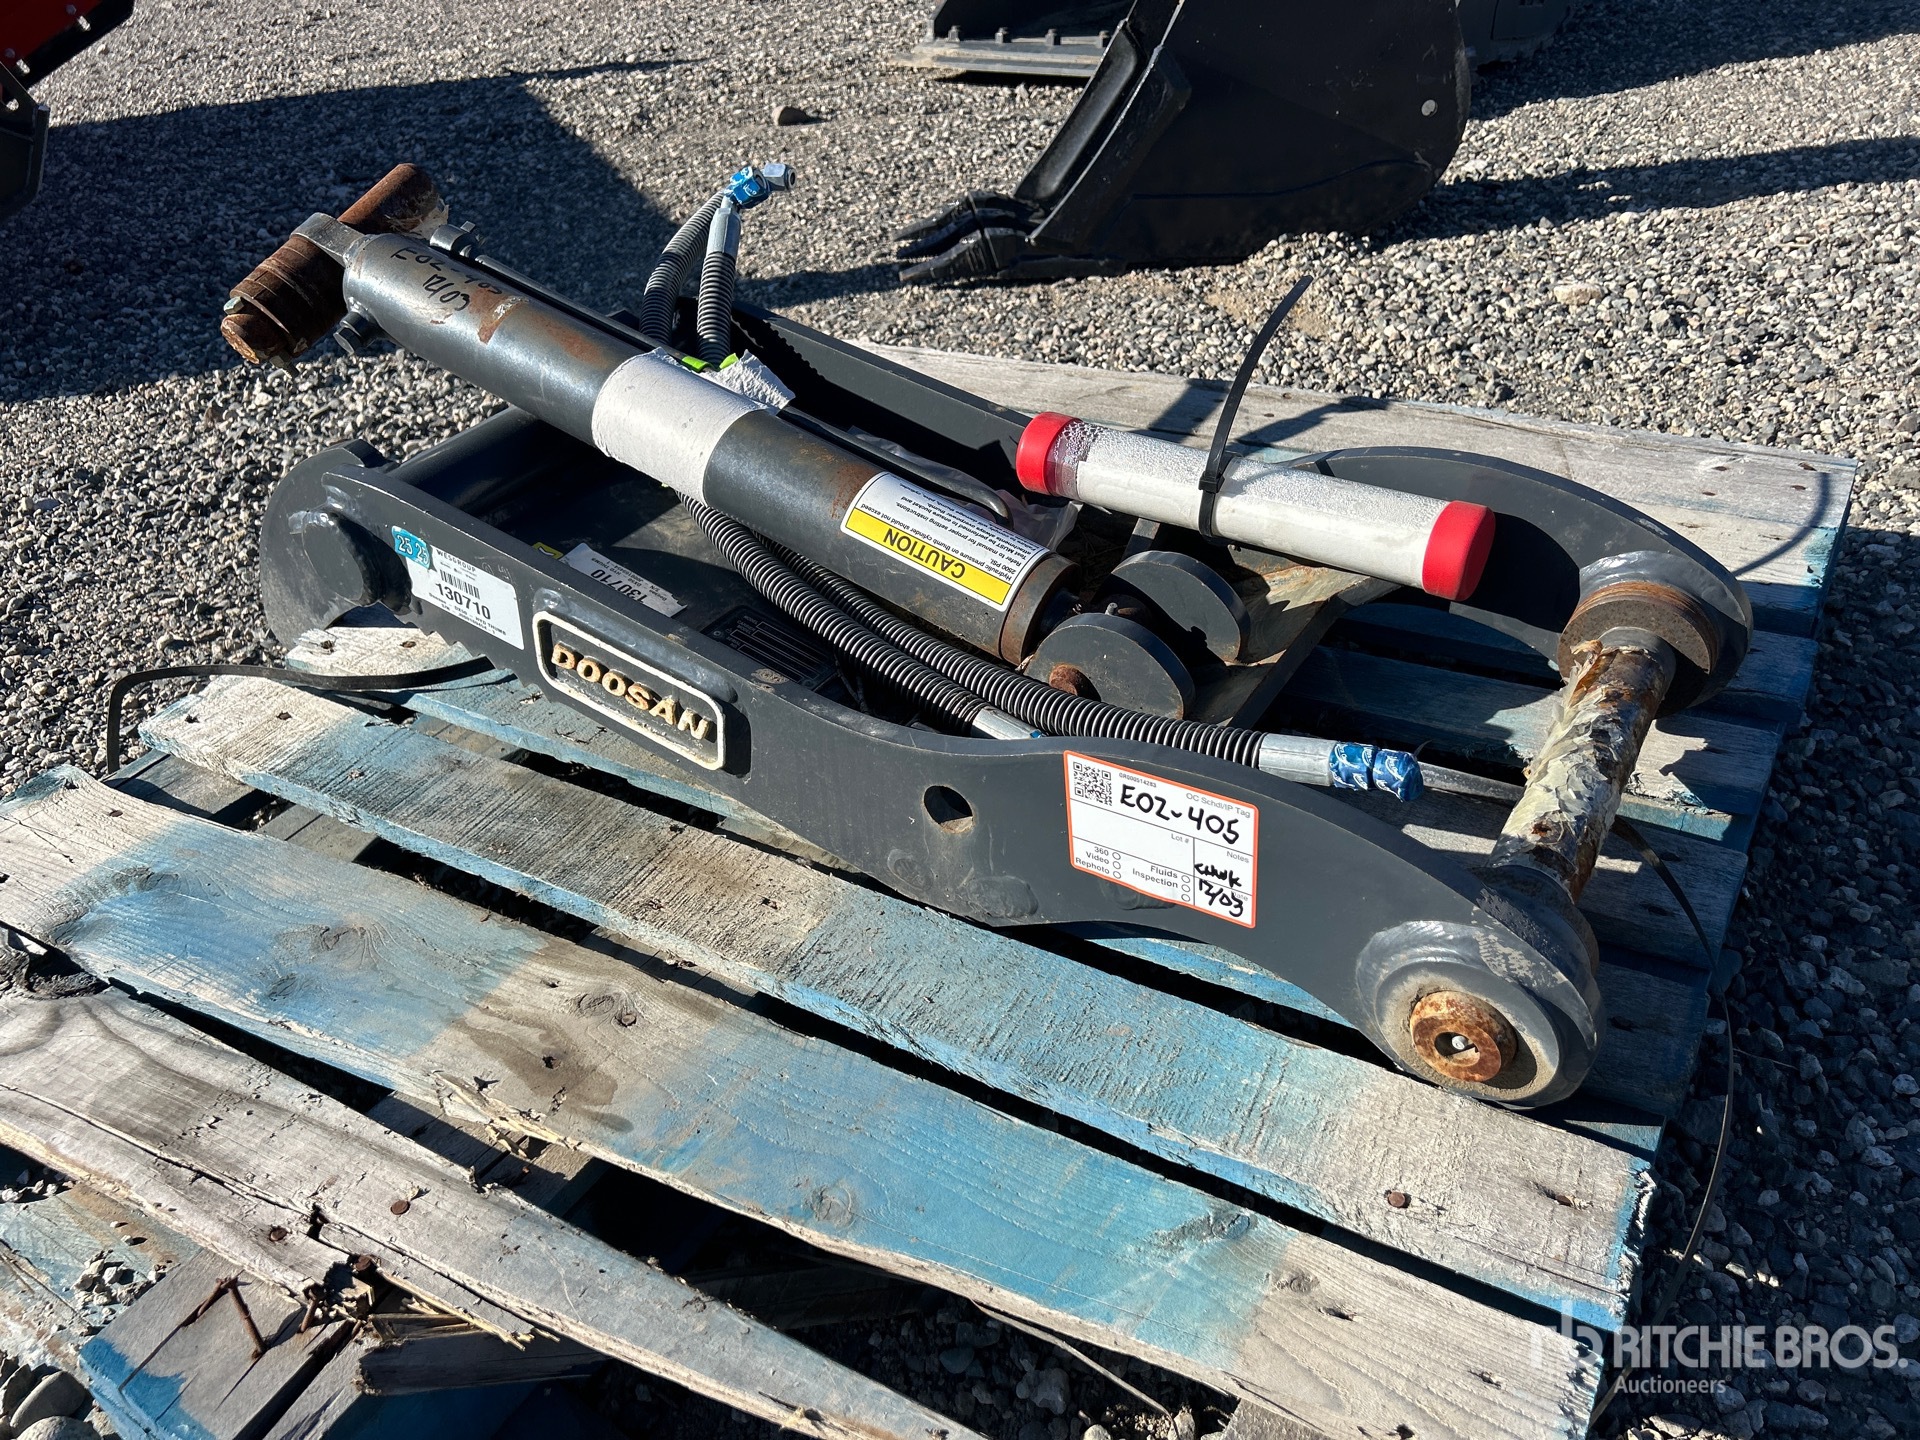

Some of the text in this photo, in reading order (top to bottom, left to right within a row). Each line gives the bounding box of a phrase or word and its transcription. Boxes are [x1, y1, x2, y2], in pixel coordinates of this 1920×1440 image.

[859, 503, 881, 515] exceed
[911, 501, 932, 513] bucket
[931, 511, 952, 521] ensure
[889, 518, 911, 530] should
[927, 517, 950, 530] setting
[909, 527, 933, 541] cylinder
[946, 527, 969, 539] proper
[957, 523, 989, 540] performed
[974, 526, 997, 537] always
[397, 534, 413, 555] 25
[931, 538, 952, 550] thumb
[975, 541, 999, 555] manual
[995, 542, 1014, 553] MUST
[883, 528, 965, 579] CAUTION
[958, 551, 986, 566] pressure
[1012, 551, 1028, 559] Test
[437, 550, 476, 572] WESGROUP
[1003, 556, 1022, 566] Refer
[983, 564, 1013, 580] Hydraulic
[999, 564, 1017, 574] 2500
[590, 569, 648, 603] 130710
[436, 583, 491, 620] 130710
[551, 641, 711, 740] DOOSAN
[1186, 792, 1200, 802] OC
[1235, 806, 1251, 818] Tag
[1171, 833, 1183, 843] Lot
[1085, 851, 1110, 865] Video
[1094, 846, 1109, 857] 360
[1226, 851, 1250, 864] Notes
[1076, 857, 1110, 875] Rephoto
[1150, 865, 1178, 879] Fluids
[1132, 868, 1178, 889] Inspection
